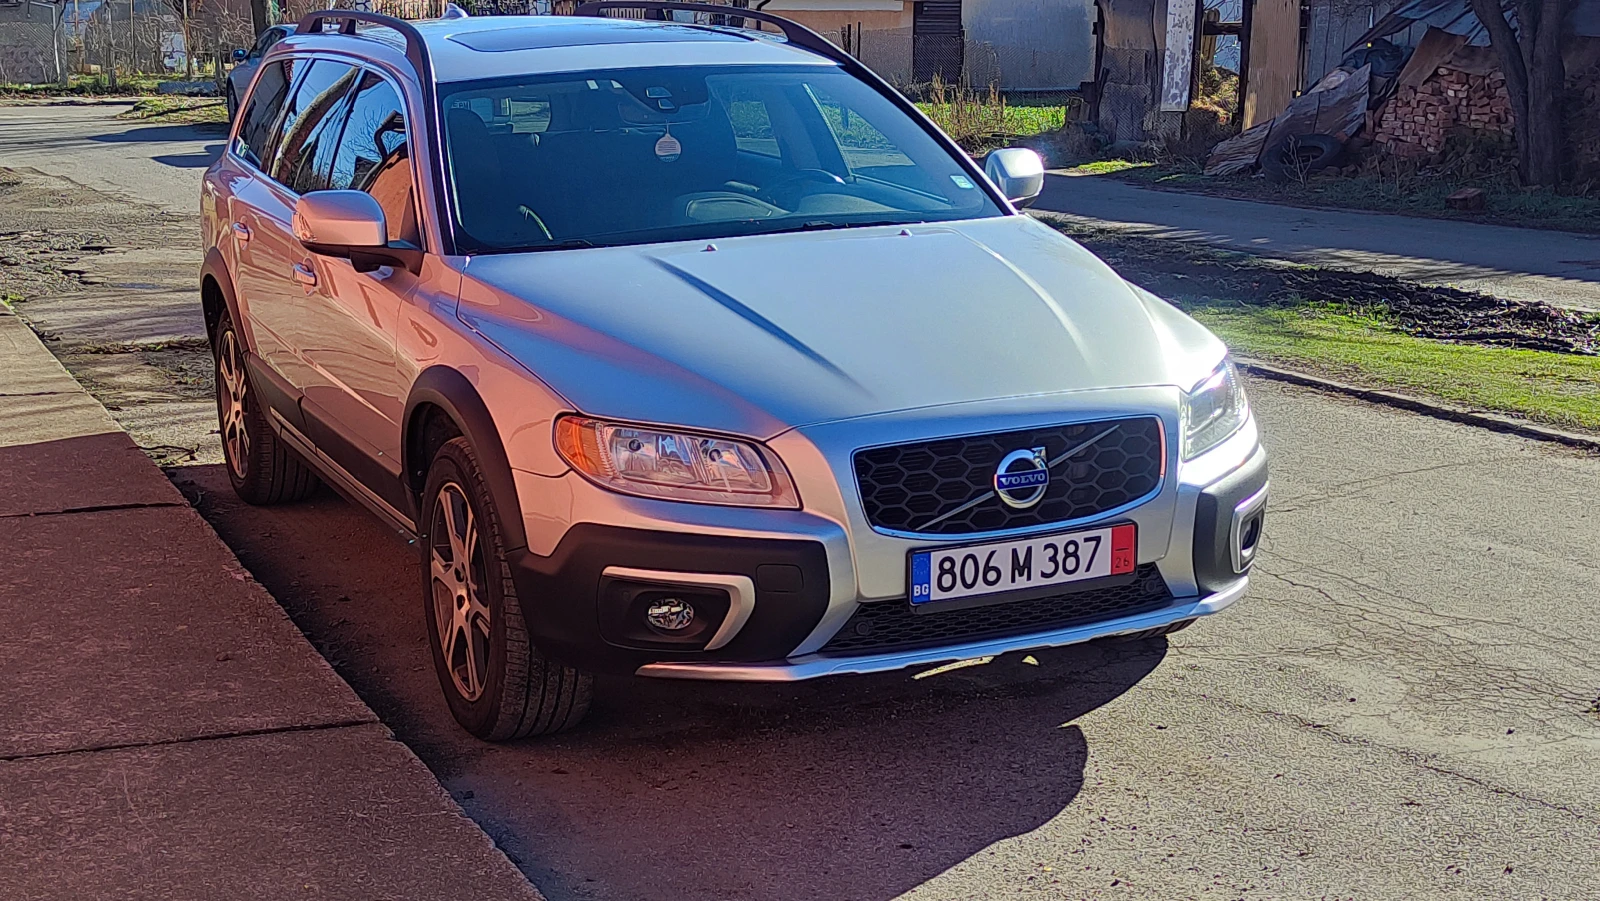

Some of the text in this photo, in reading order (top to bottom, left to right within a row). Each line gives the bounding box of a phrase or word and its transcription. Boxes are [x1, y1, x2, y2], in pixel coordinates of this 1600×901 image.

[999, 473, 1045, 485] VOLVO
[937, 535, 1102, 592] 806 M 387
[1115, 557, 1129, 569] 26
[913, 583, 930, 597] BG
